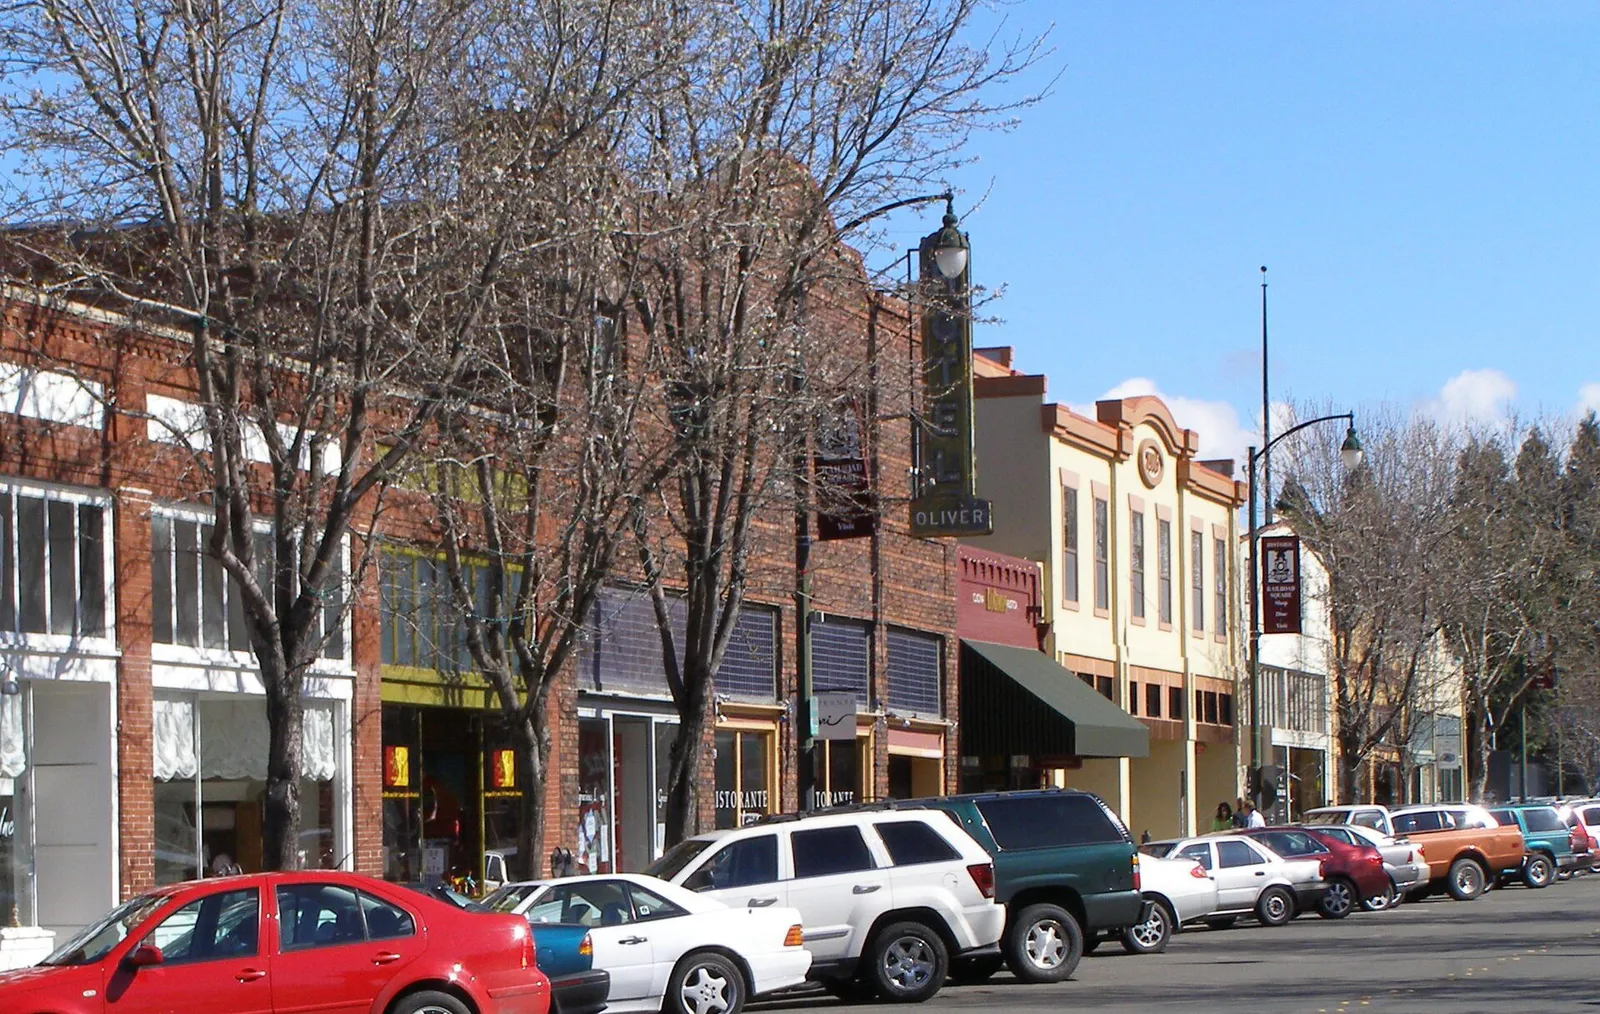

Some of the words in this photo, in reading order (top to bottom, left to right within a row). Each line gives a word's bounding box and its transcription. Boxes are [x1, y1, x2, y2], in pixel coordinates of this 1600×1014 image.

[930, 268, 961, 484] OTEL
[916, 508, 983, 526] OLIVER
[715, 790, 768, 809] ISTORANTE
[815, 791, 854, 808] TORANTE
